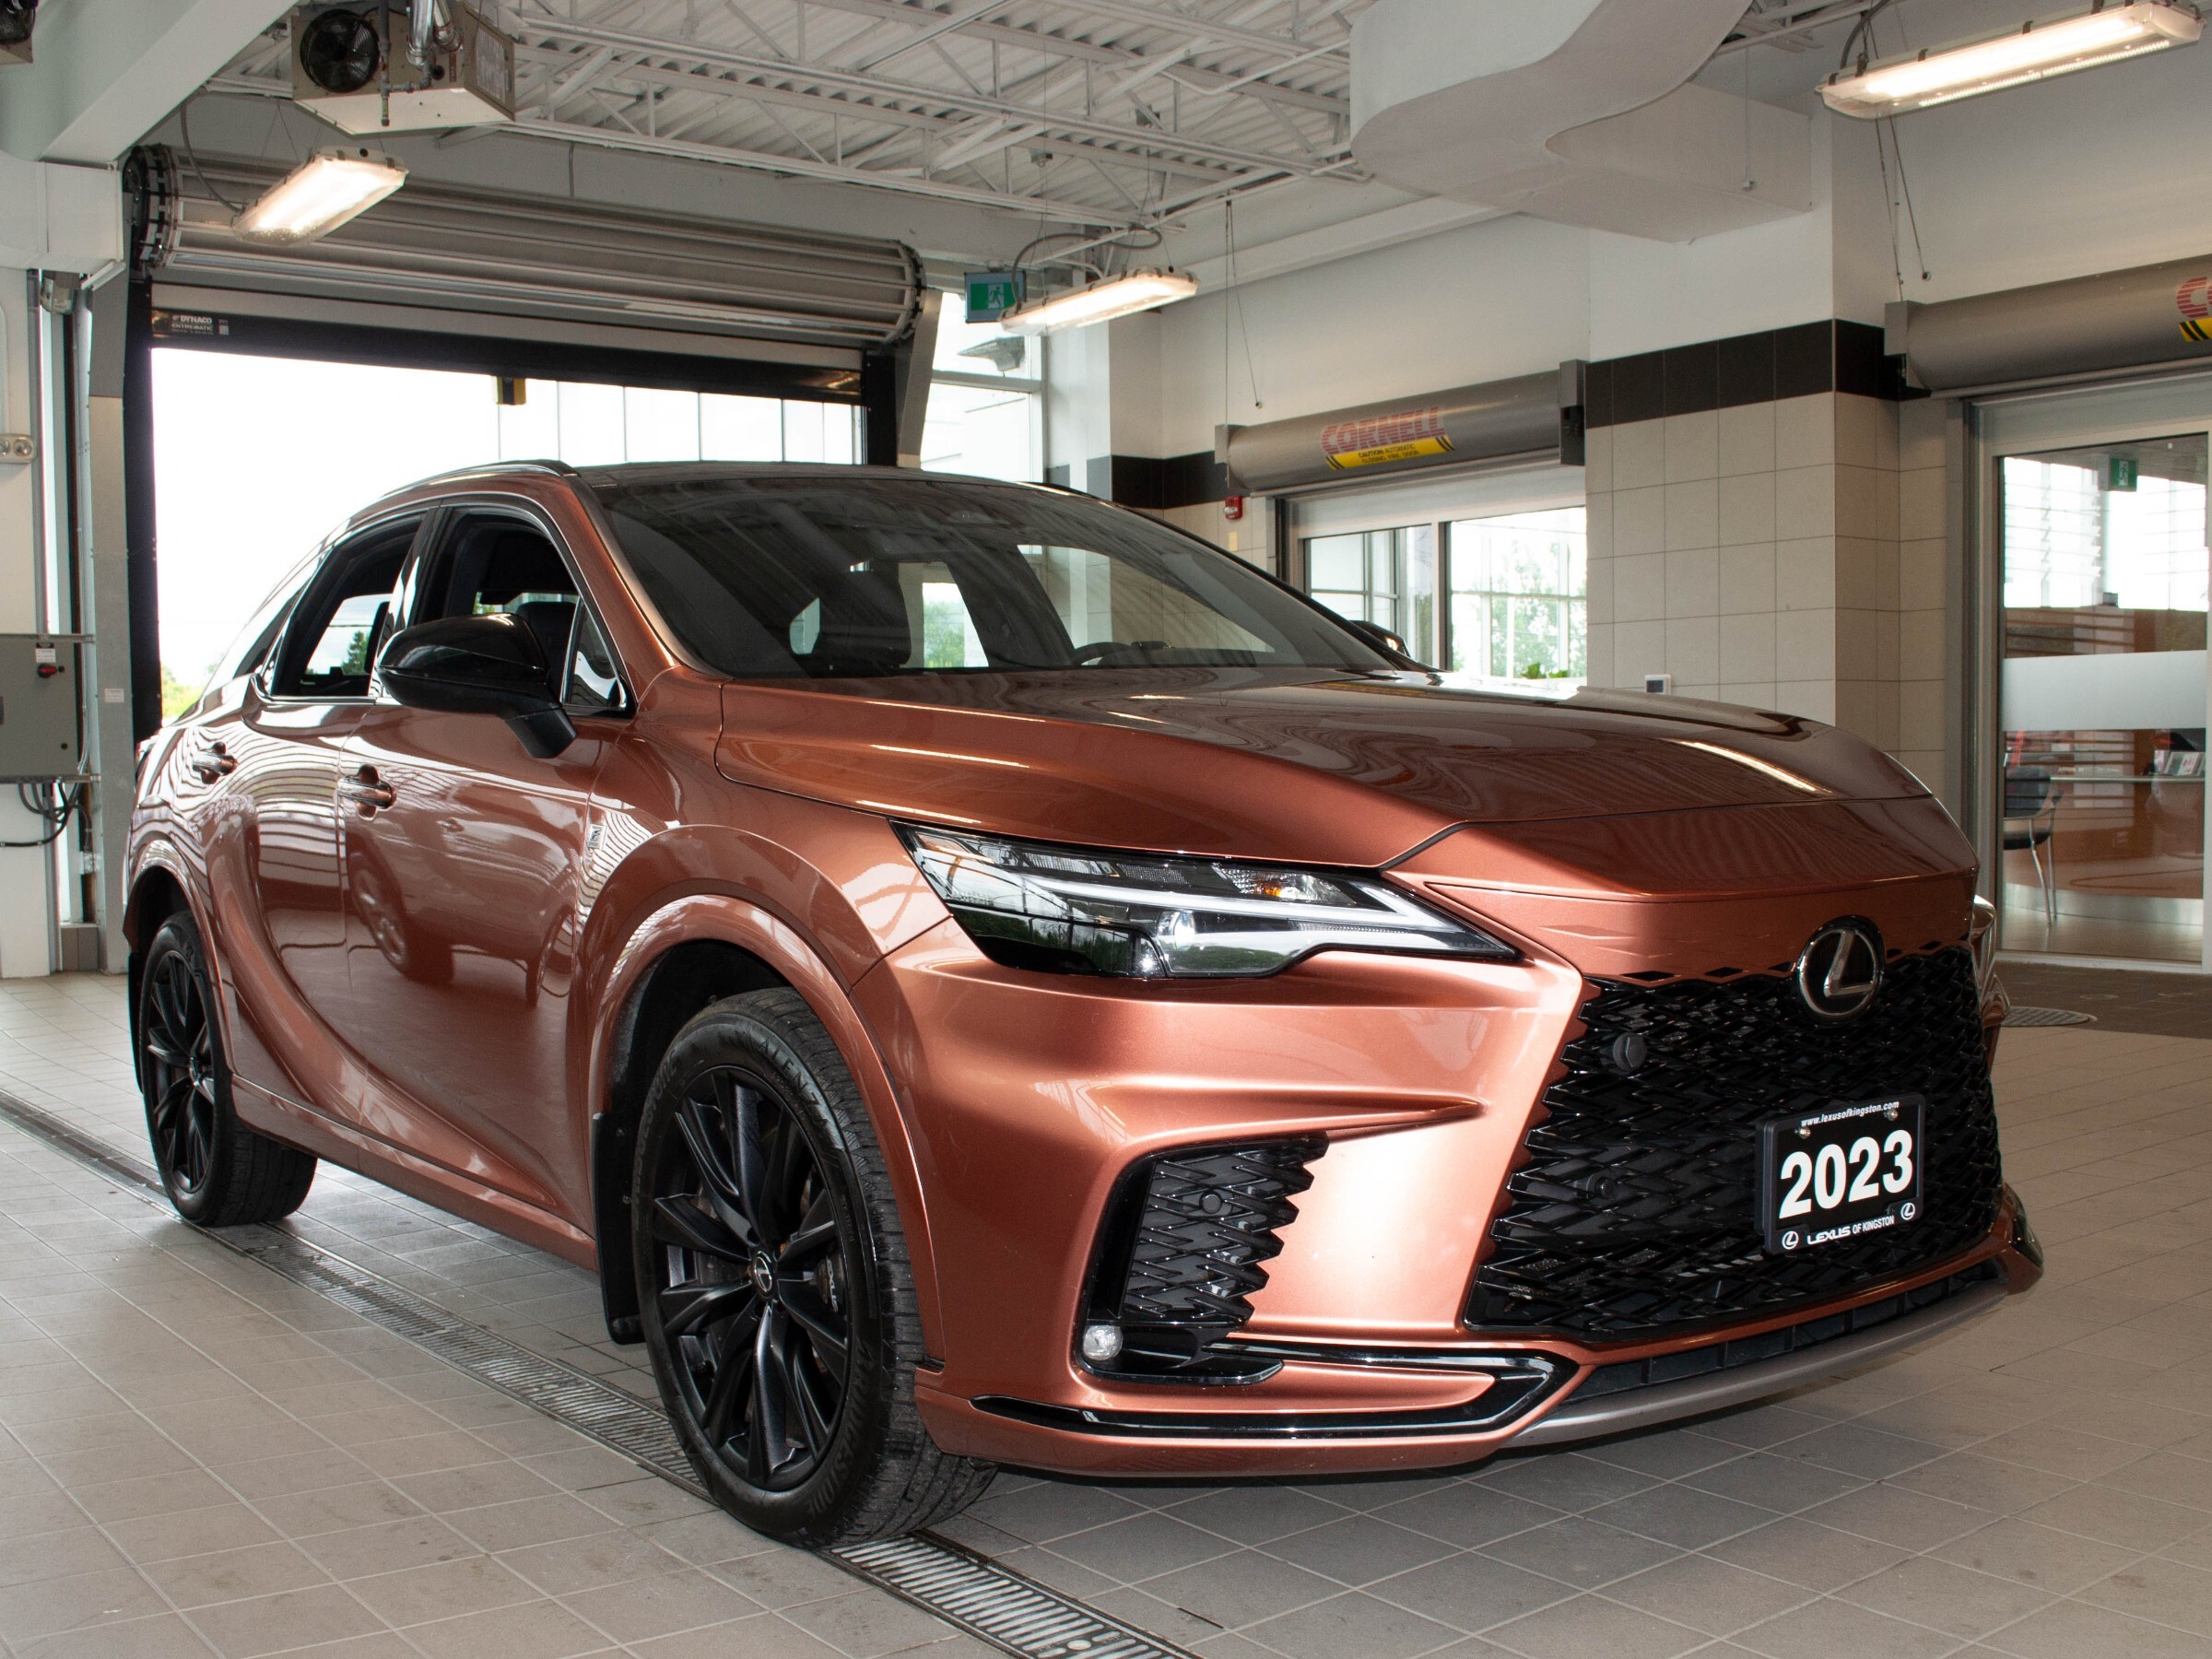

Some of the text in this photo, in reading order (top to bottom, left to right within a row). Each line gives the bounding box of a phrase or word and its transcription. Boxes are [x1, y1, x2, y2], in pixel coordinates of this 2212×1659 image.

[180, 314, 213, 324] DYNACO
[1322, 406, 1446, 454] CORNELL
[1801, 1100, 1900, 1126] www.lexusofkingston.com
[1779, 1130, 1913, 1218] 2023
[1806, 1215, 1895, 1244] LEXUS OF KINGSTON
